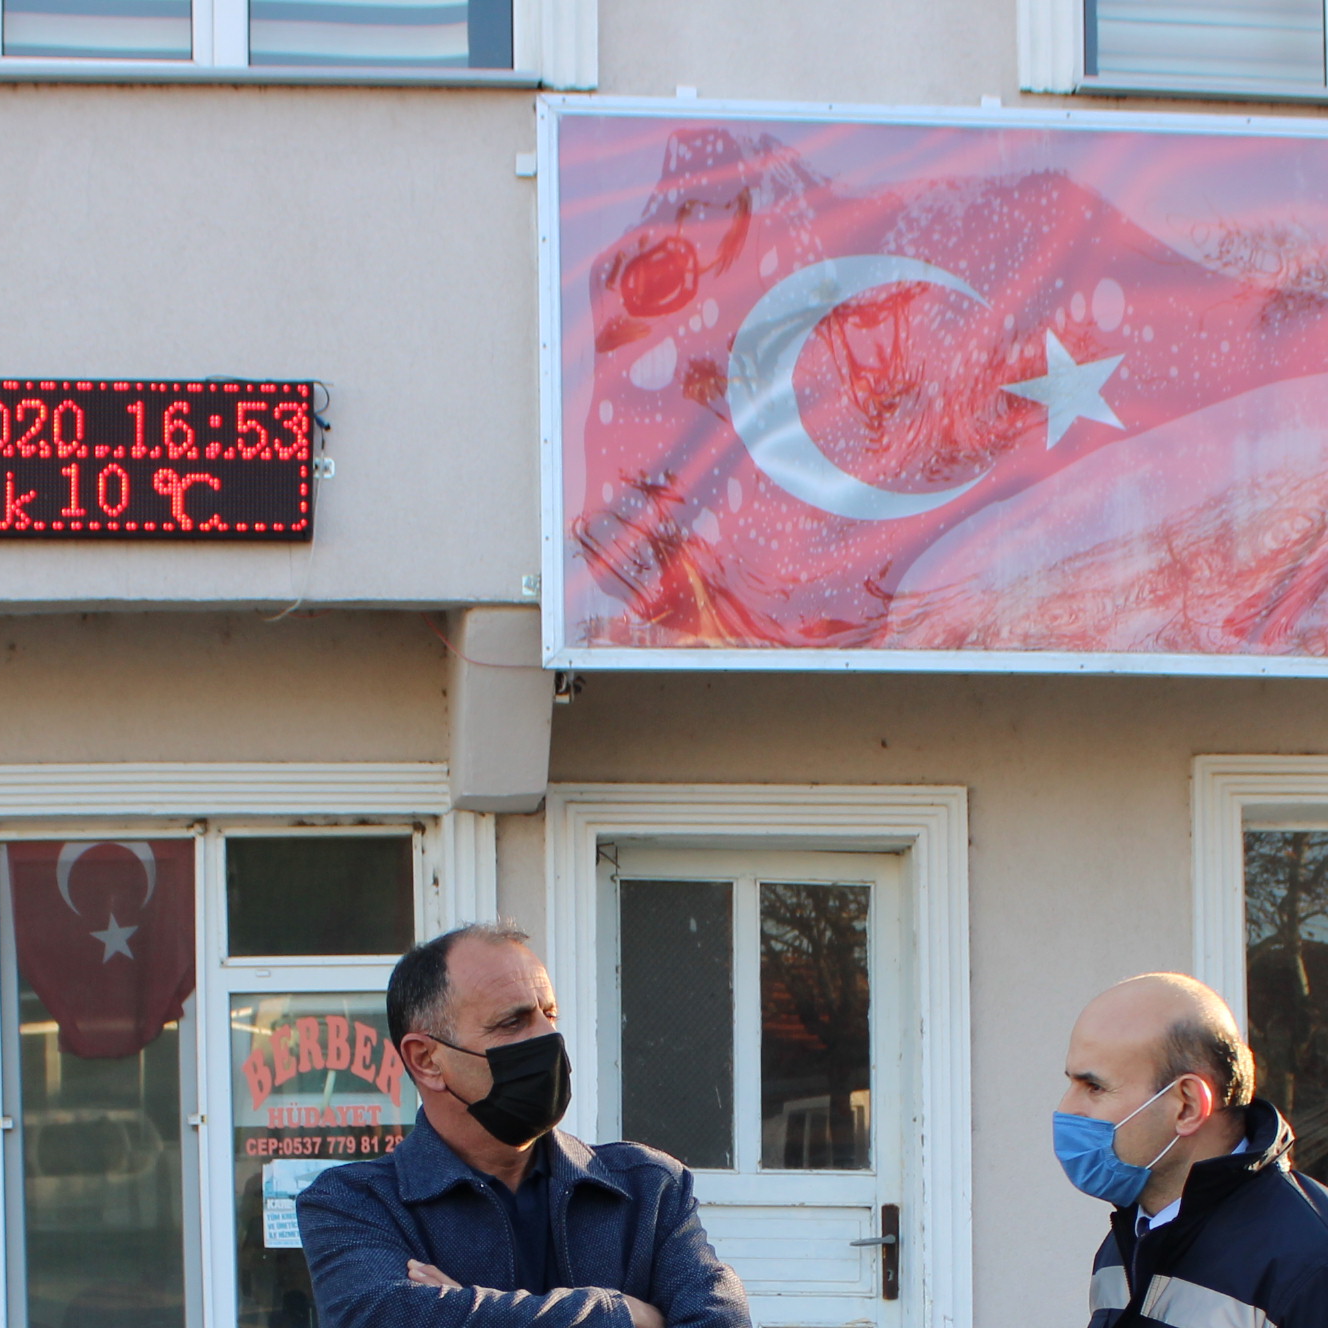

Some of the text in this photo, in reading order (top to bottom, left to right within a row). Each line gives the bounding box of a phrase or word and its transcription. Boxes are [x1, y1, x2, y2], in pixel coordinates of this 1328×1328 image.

[127, 400, 304, 458] 16:53
[61, 463, 130, 517] 10
[242, 1015, 404, 1111] BERBER
[267, 1102, 382, 1129] HÜDAYET
[245, 1137, 322, 1156] CEP:0537
[327, 1136, 356, 1155] 779
[360, 1135, 379, 1154] 81
